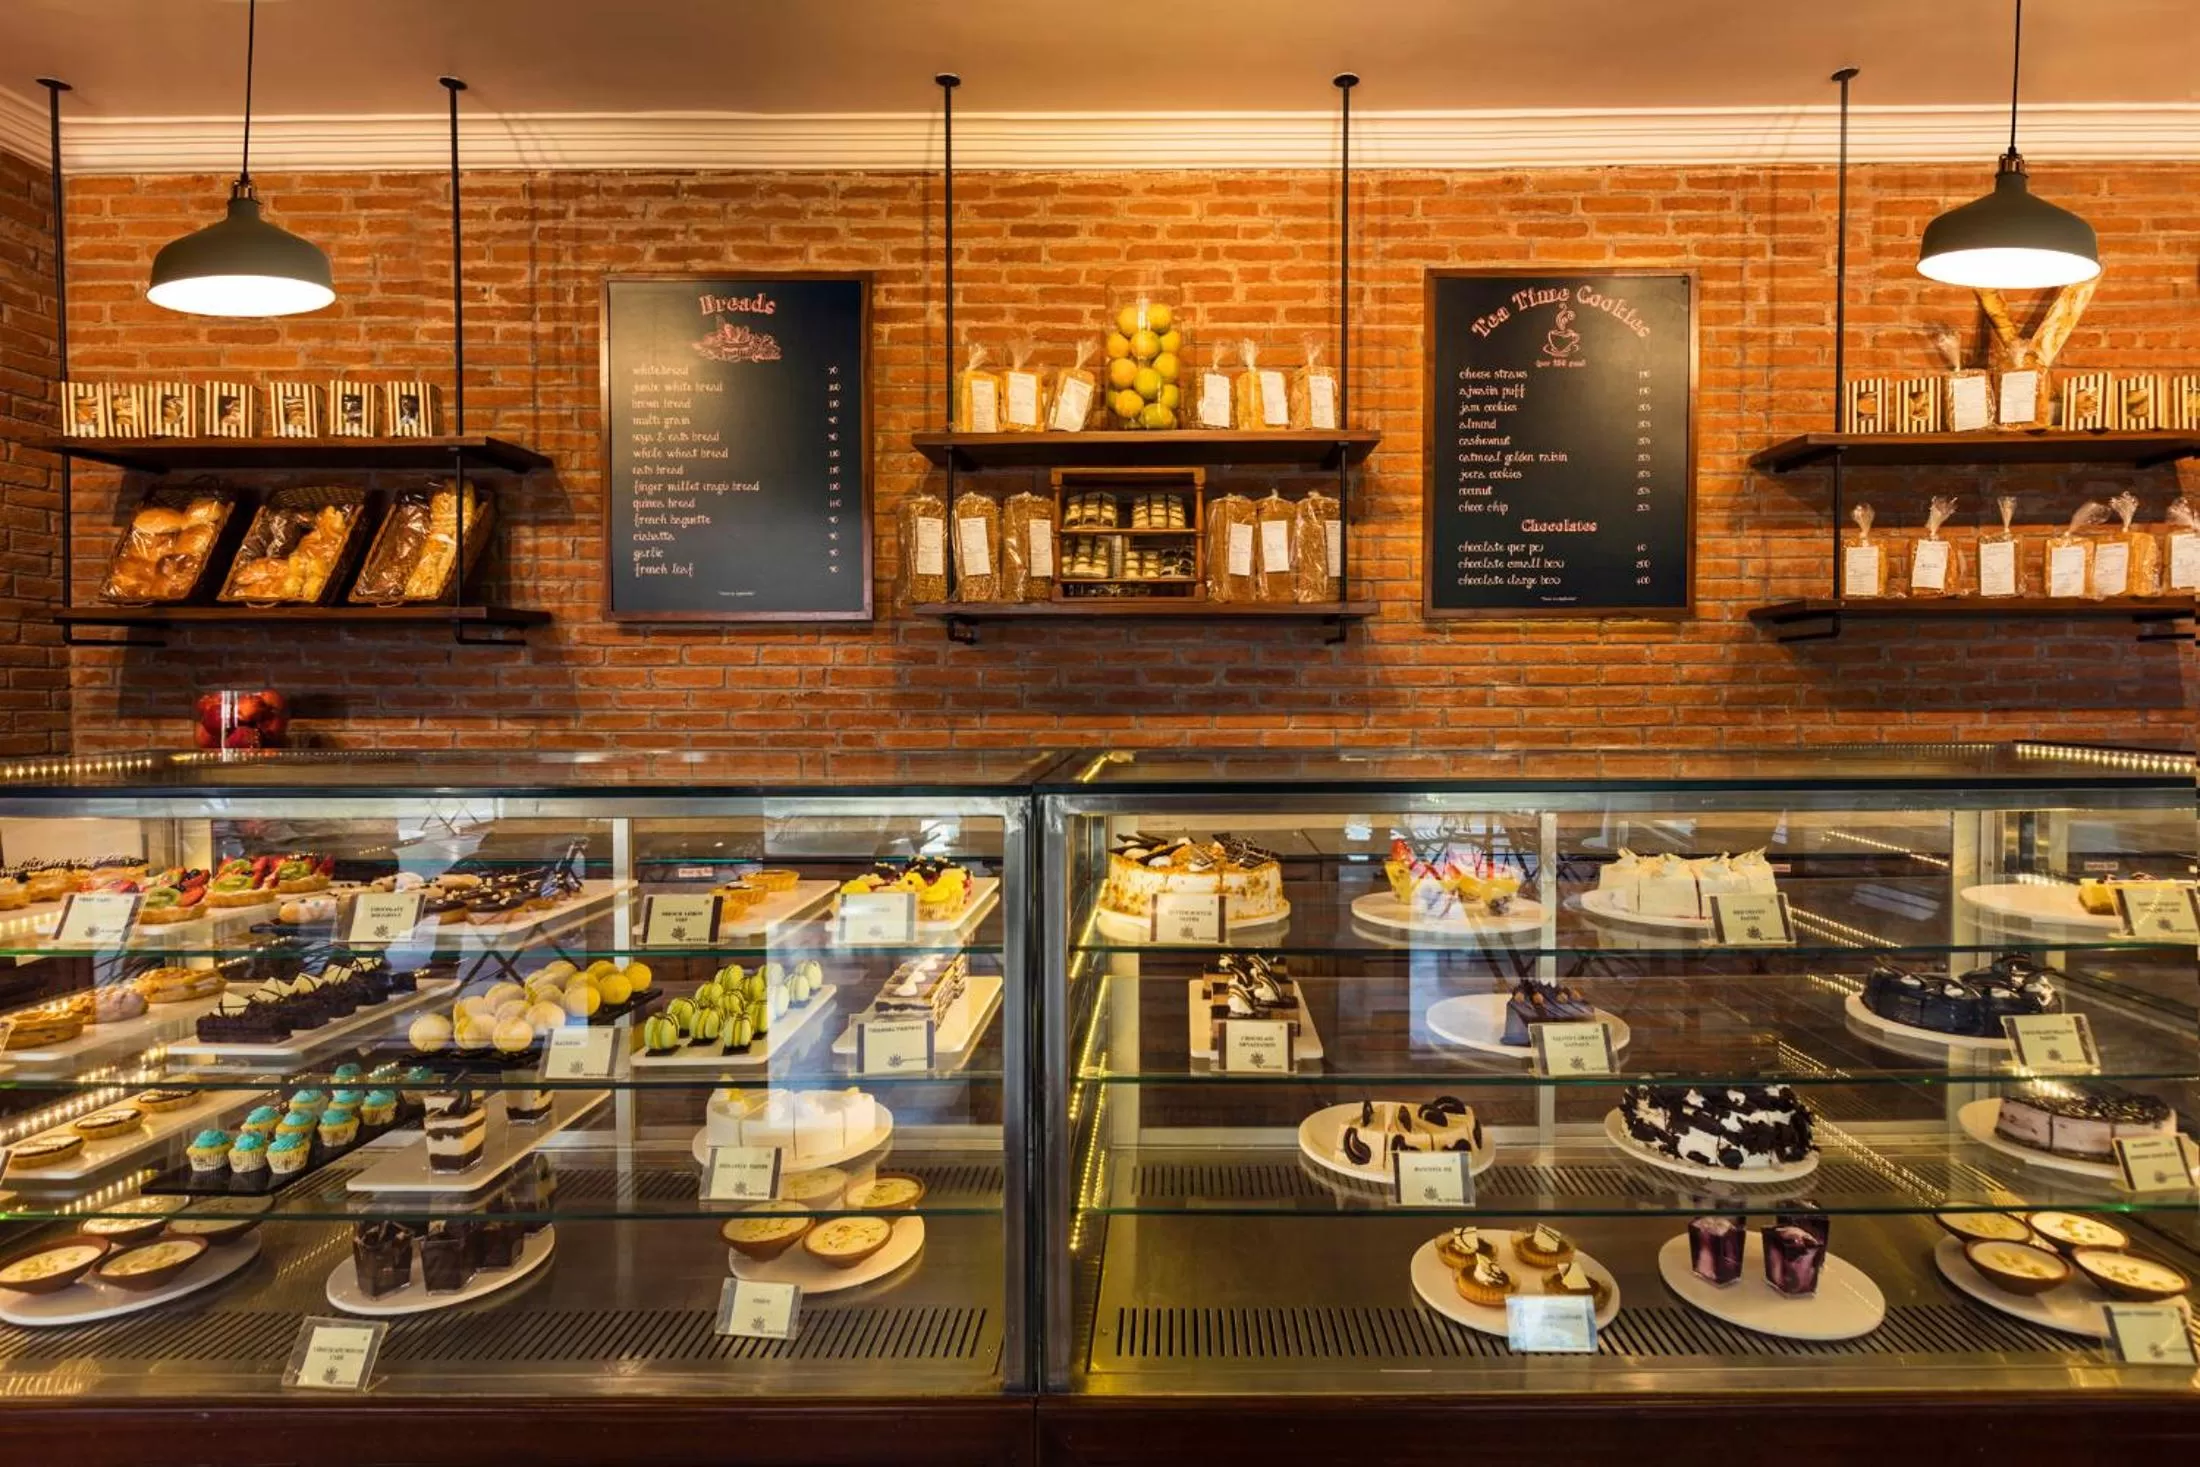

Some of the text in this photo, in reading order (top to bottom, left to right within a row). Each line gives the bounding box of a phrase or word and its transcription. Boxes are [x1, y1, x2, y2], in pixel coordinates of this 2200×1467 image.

[699, 293, 776, 316] Breads
[1470, 284, 1652, 339] Tea Time Cookies
[1459, 366, 1492, 380] cheese
[1494, 368, 1528, 380] straws
[695, 380, 724, 392] bread
[1502, 383, 1527, 400] puff
[664, 397, 692, 409] bread
[1459, 400, 1480, 416] jam
[1484, 401, 1518, 412] cookies
[1459, 417, 1497, 430] almond
[692, 430, 720, 442] bread
[1459, 434, 1512, 446] cashewnut
[633, 447, 663, 459] whole
[666, 447, 698, 459] wheat
[701, 447, 729, 459] bread
[1459, 450, 1501, 463] oatmeal
[1504, 450, 1534, 466] golden
[1539, 451, 1569, 463] raisin
[655, 464, 685, 475] bread
[1489, 468, 1523, 480] cookies
[634, 480, 664, 496] finger
[667, 480, 700, 491] millet
[732, 481, 761, 491] bread
[668, 497, 697, 509] bread
[1458, 500, 1484, 513] choco
[1487, 500, 1509, 516] chip
[634, 512, 667, 528] french
[669, 513, 713, 528] baguette
[1521, 518, 1598, 533] Chocolates
[1457, 540, 1505, 553] chocolate
[1457, 557, 1505, 569] chocolate
[635, 562, 668, 578] french
[1457, 573, 1505, 586] chocolate
